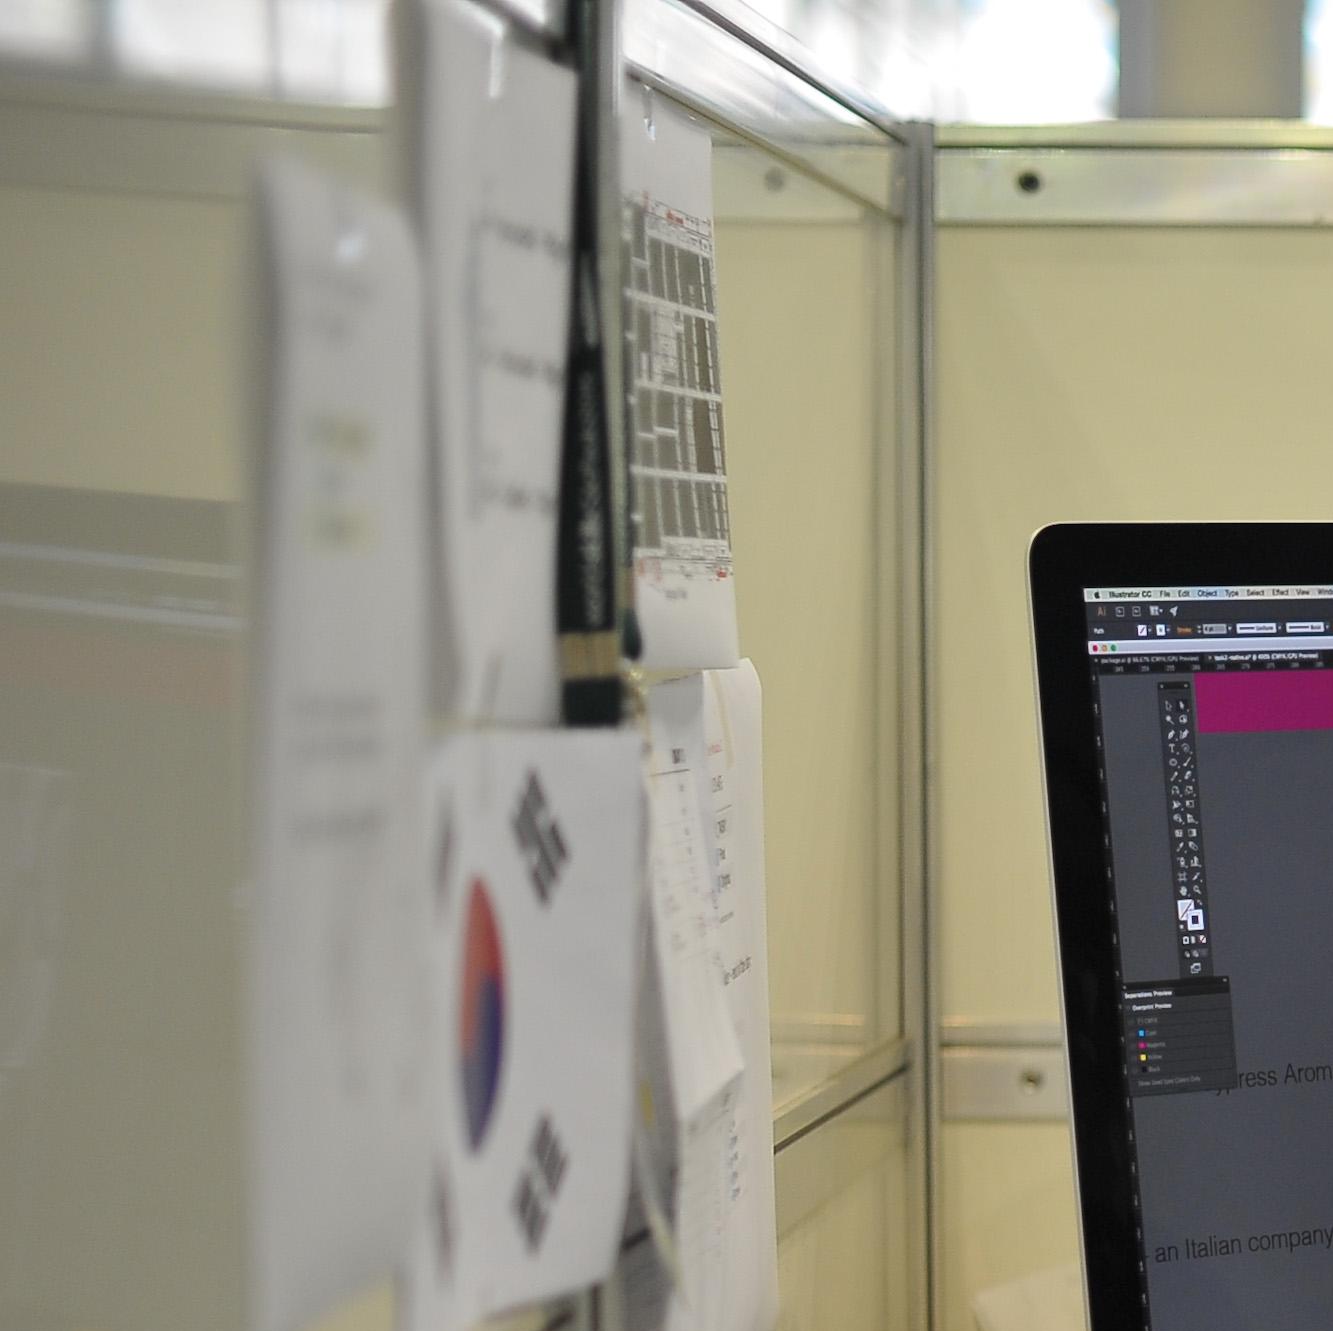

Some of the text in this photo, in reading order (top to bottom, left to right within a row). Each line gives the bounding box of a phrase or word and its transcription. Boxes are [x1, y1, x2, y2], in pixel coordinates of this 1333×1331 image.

[1109, 590, 1140, 599] Illustrator
[1141, 590, 1152, 598] CC
[1160, 590, 1171, 598] File
[1178, 589, 1190, 598] Edit
[1197, 589, 1218, 598] Object
[1225, 588, 1239, 598] Type
[1246, 588, 1265, 597] Select
[1272, 588, 1289, 597] Effect
[1296, 588, 1310, 596] View
[1155, 1245, 1179, 1263] an
[1185, 1234, 1242, 1260] Italian
